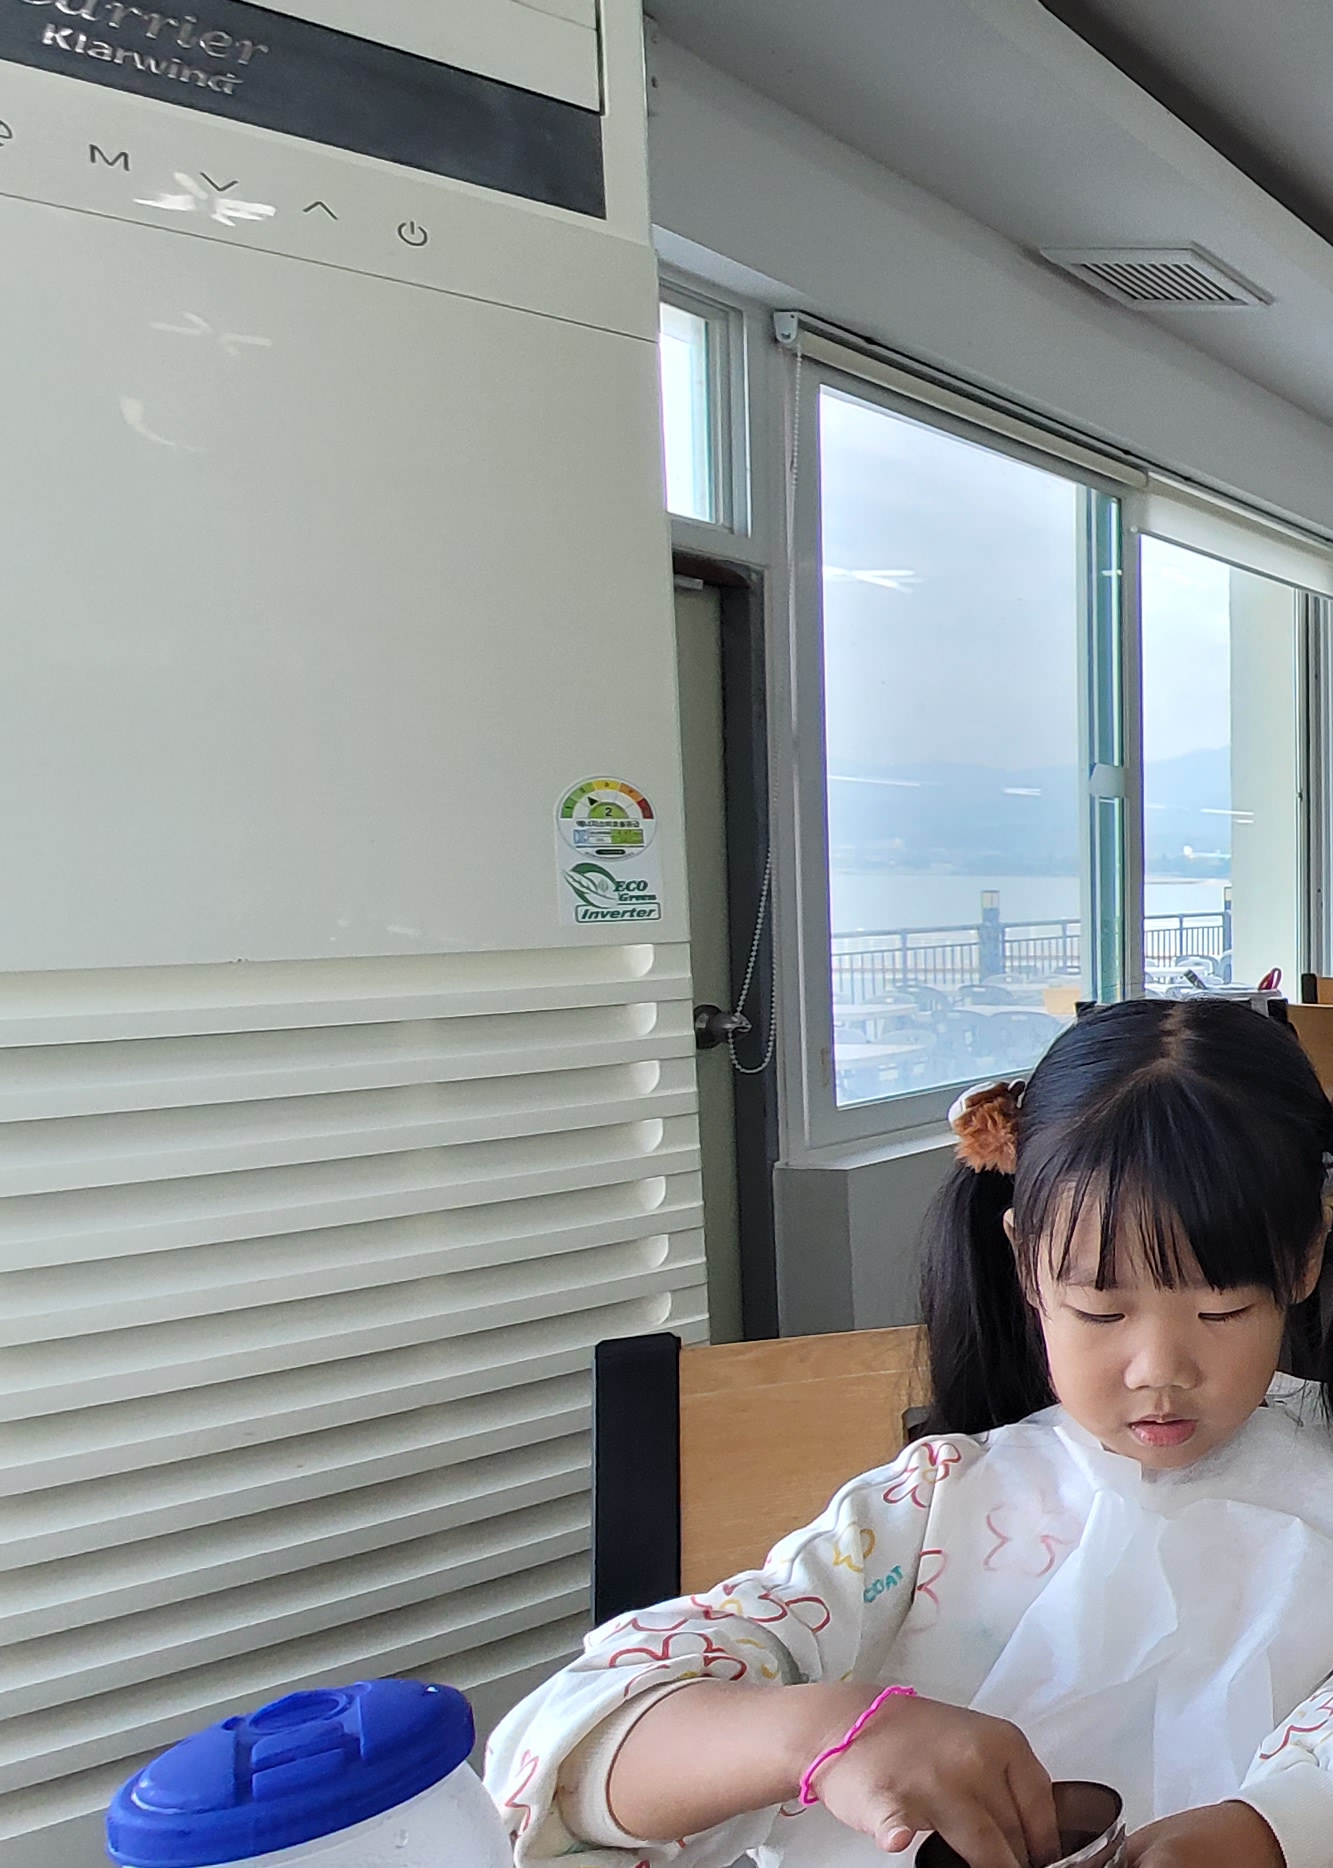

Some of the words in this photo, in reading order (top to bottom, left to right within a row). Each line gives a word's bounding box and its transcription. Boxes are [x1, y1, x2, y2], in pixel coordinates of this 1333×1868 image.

[20, 0, 269, 65] arrier
[42, 24, 244, 94] Klarwind
[89, 144, 130, 171] M
[605, 807, 613, 817] 2
[613, 880, 649, 892] ECO
[618, 893, 658, 902] Green
[581, 908, 657, 920] Inverter
